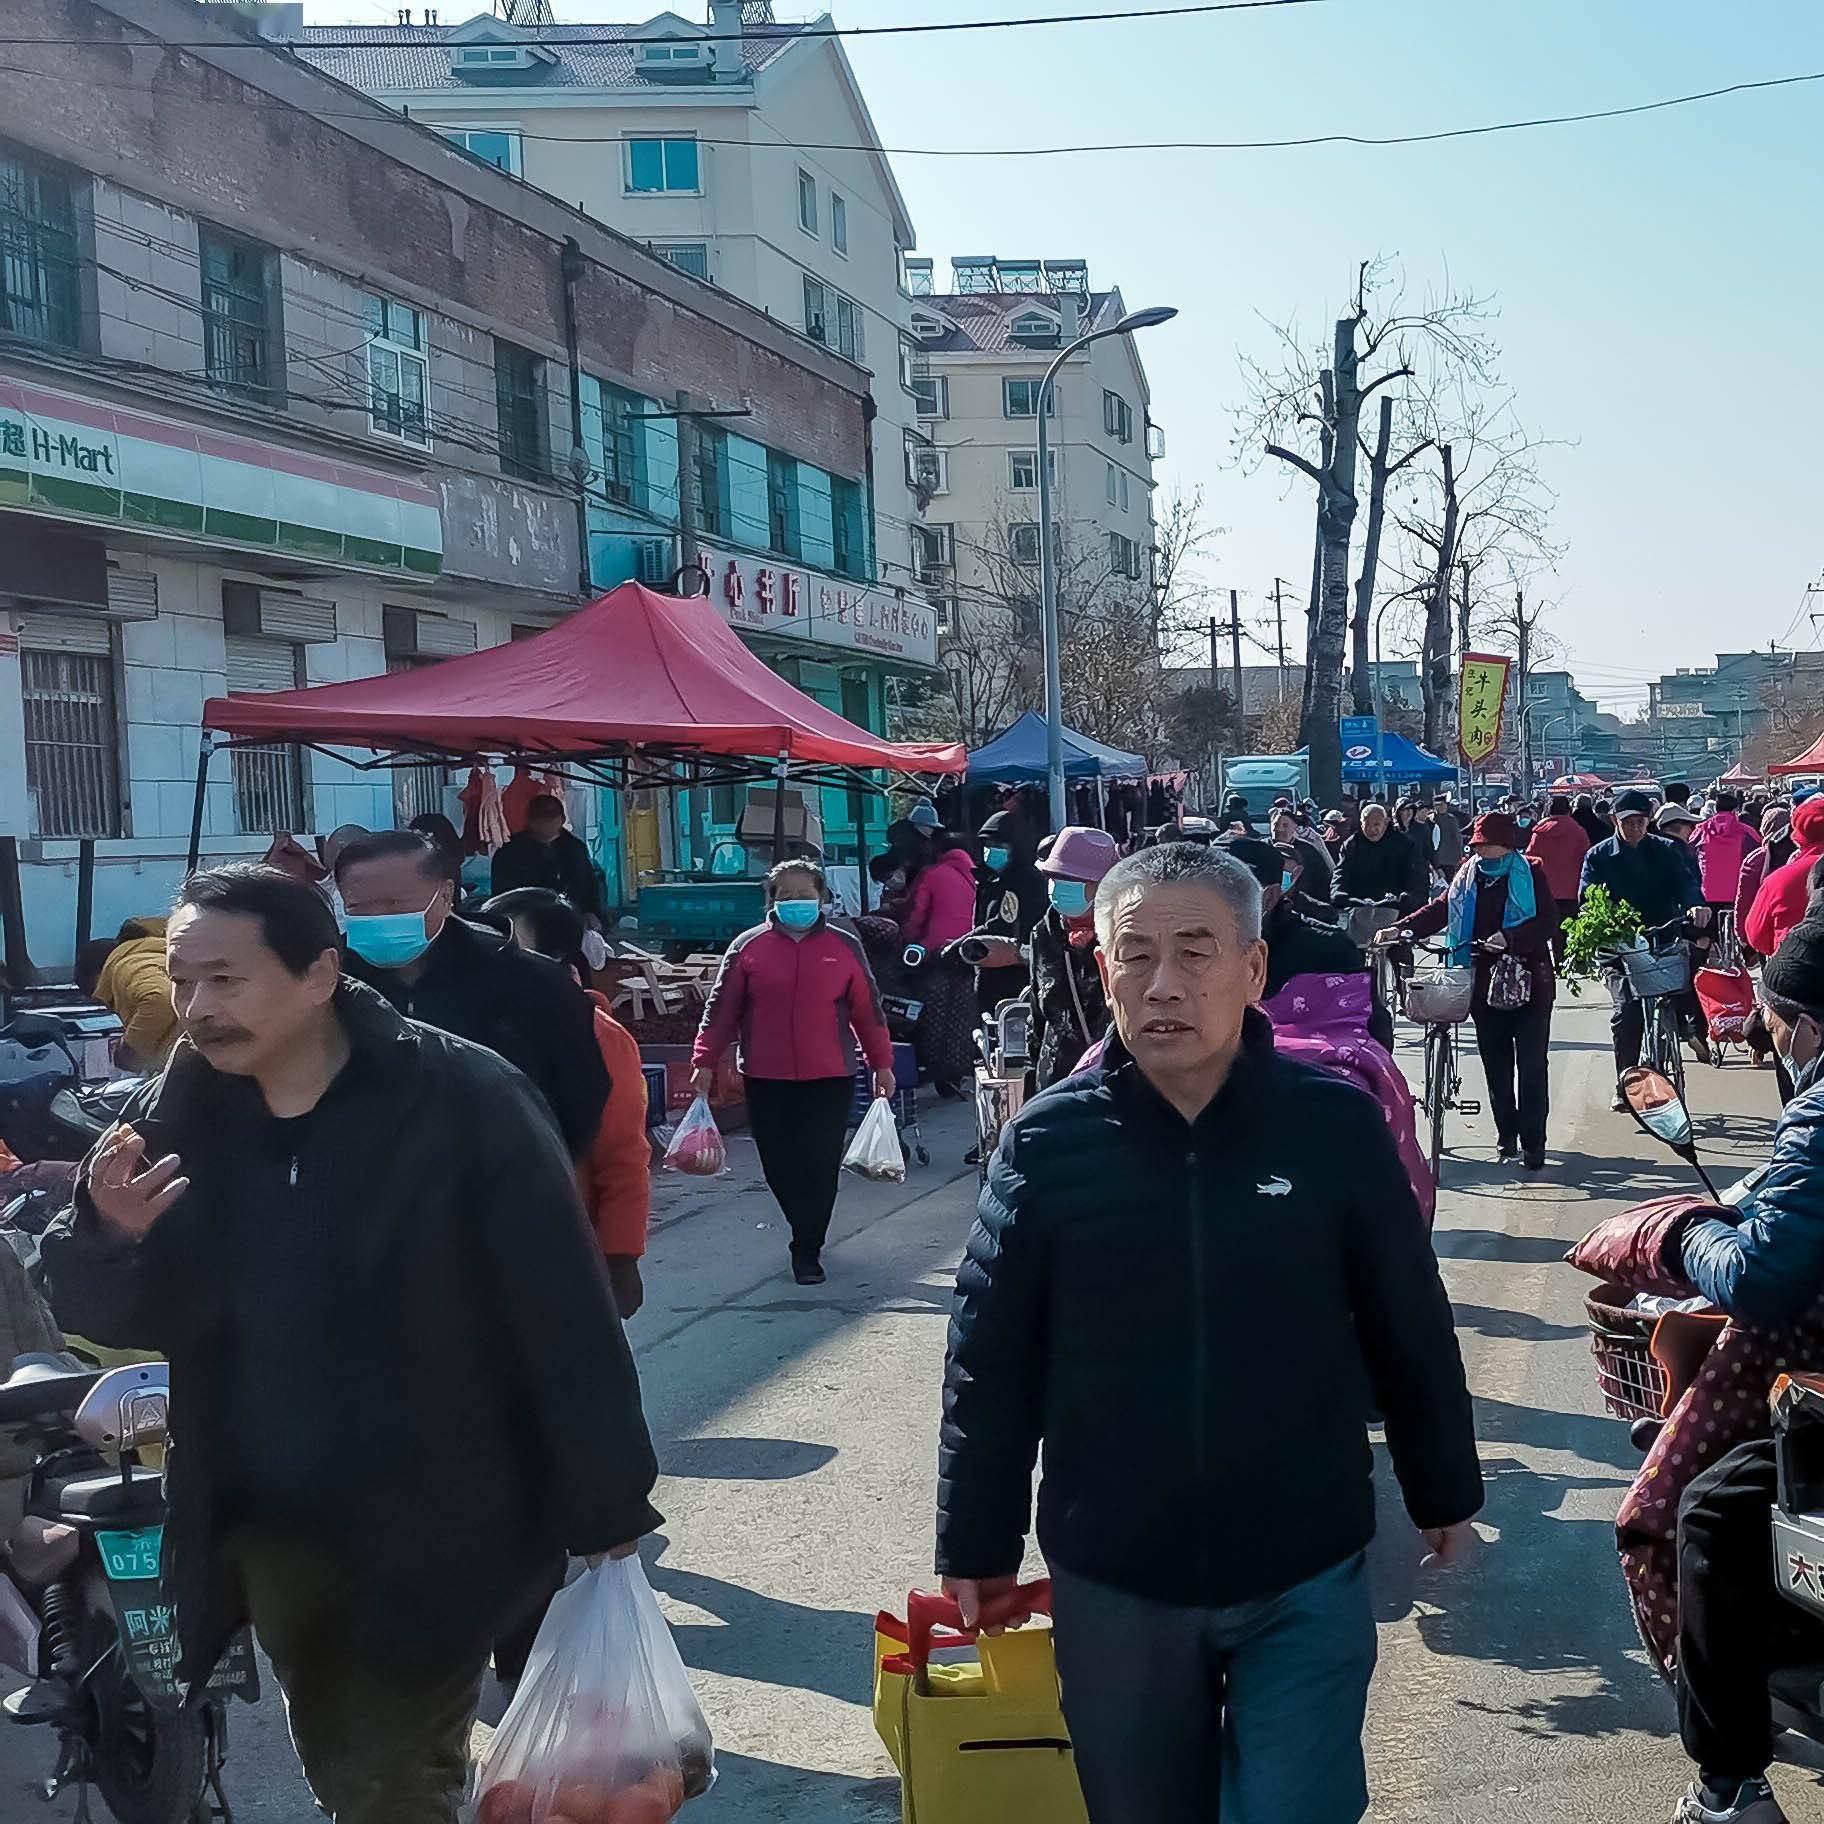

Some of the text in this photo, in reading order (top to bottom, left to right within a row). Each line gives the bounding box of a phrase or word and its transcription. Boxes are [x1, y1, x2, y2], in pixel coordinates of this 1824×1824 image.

[32, 427, 114, 475] H-Mart
[1470, 671, 1490, 747] 牛头肉
[111, 1552, 157, 1571] 075
